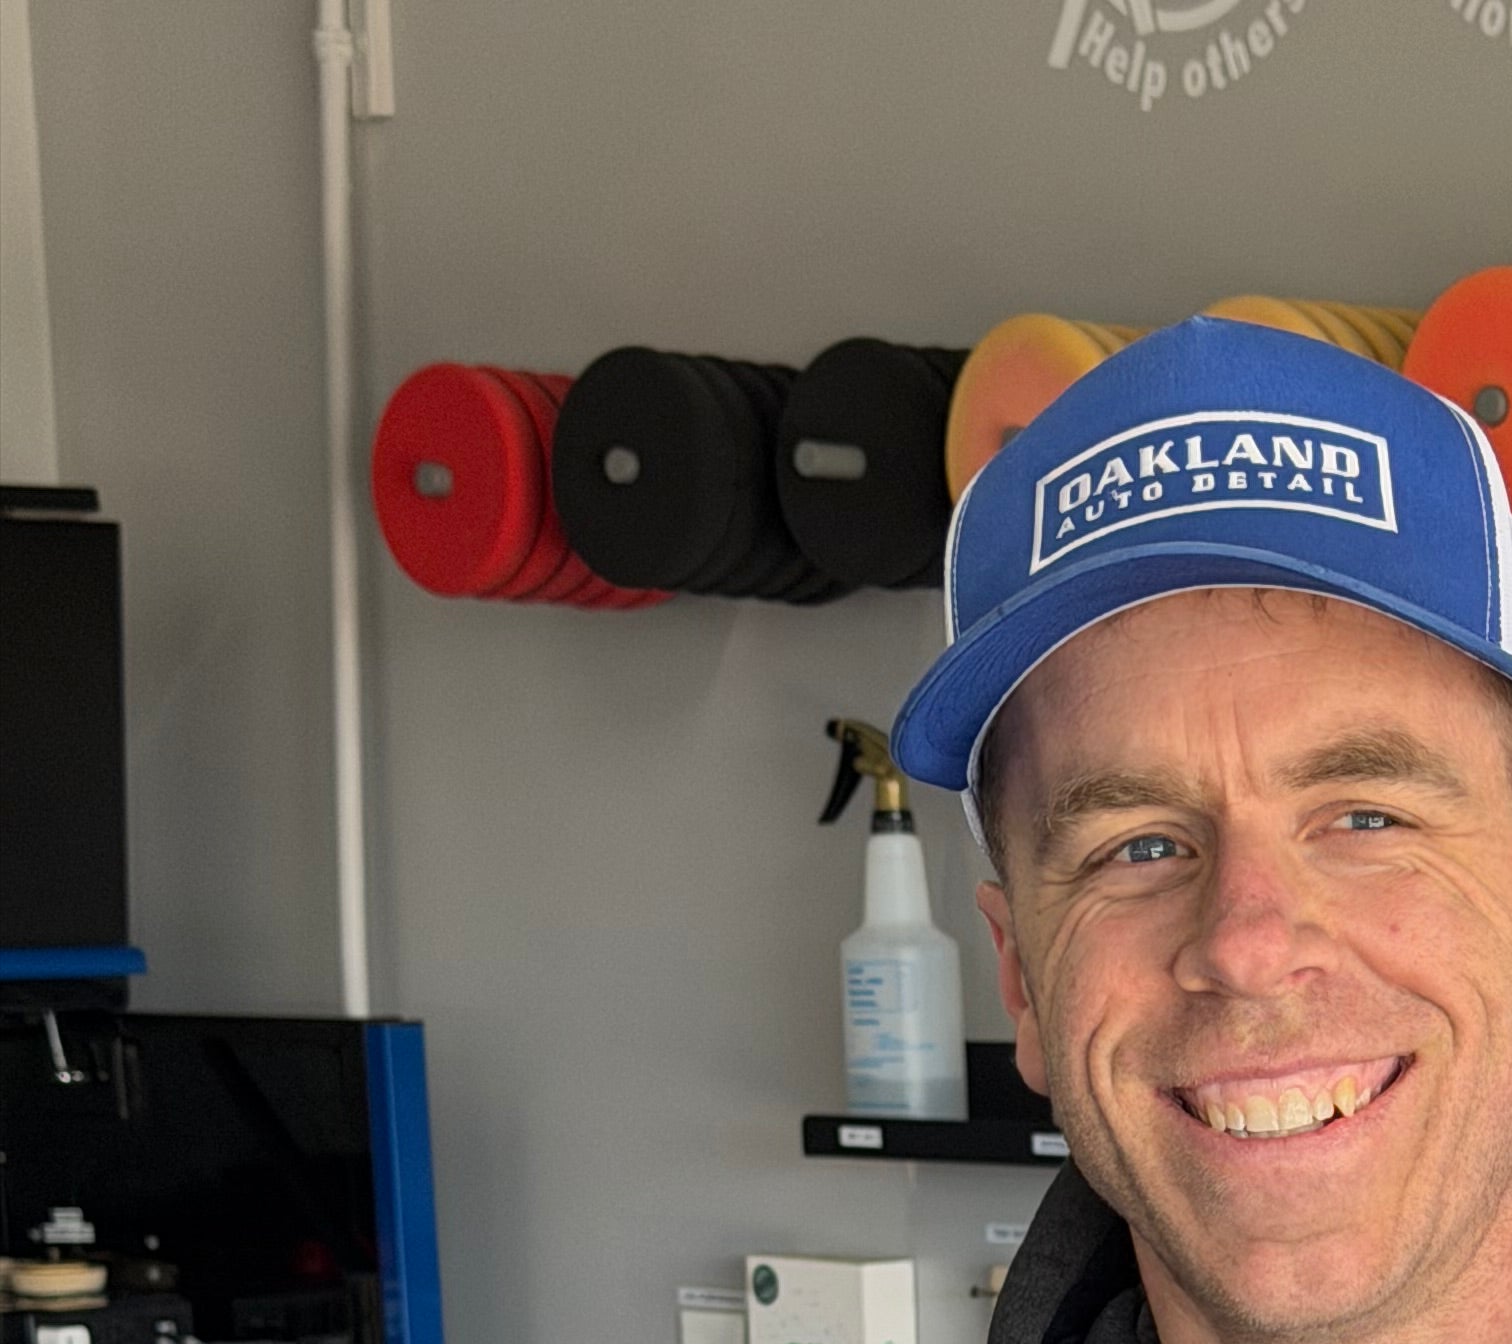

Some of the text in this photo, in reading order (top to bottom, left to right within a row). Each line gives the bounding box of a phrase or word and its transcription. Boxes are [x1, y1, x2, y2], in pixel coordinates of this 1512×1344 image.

[1078, 10, 1167, 112] Help
[1055, 471, 1364, 540] AUTO DETAIL
[1057, 433, 1361, 515] OAKLAND
